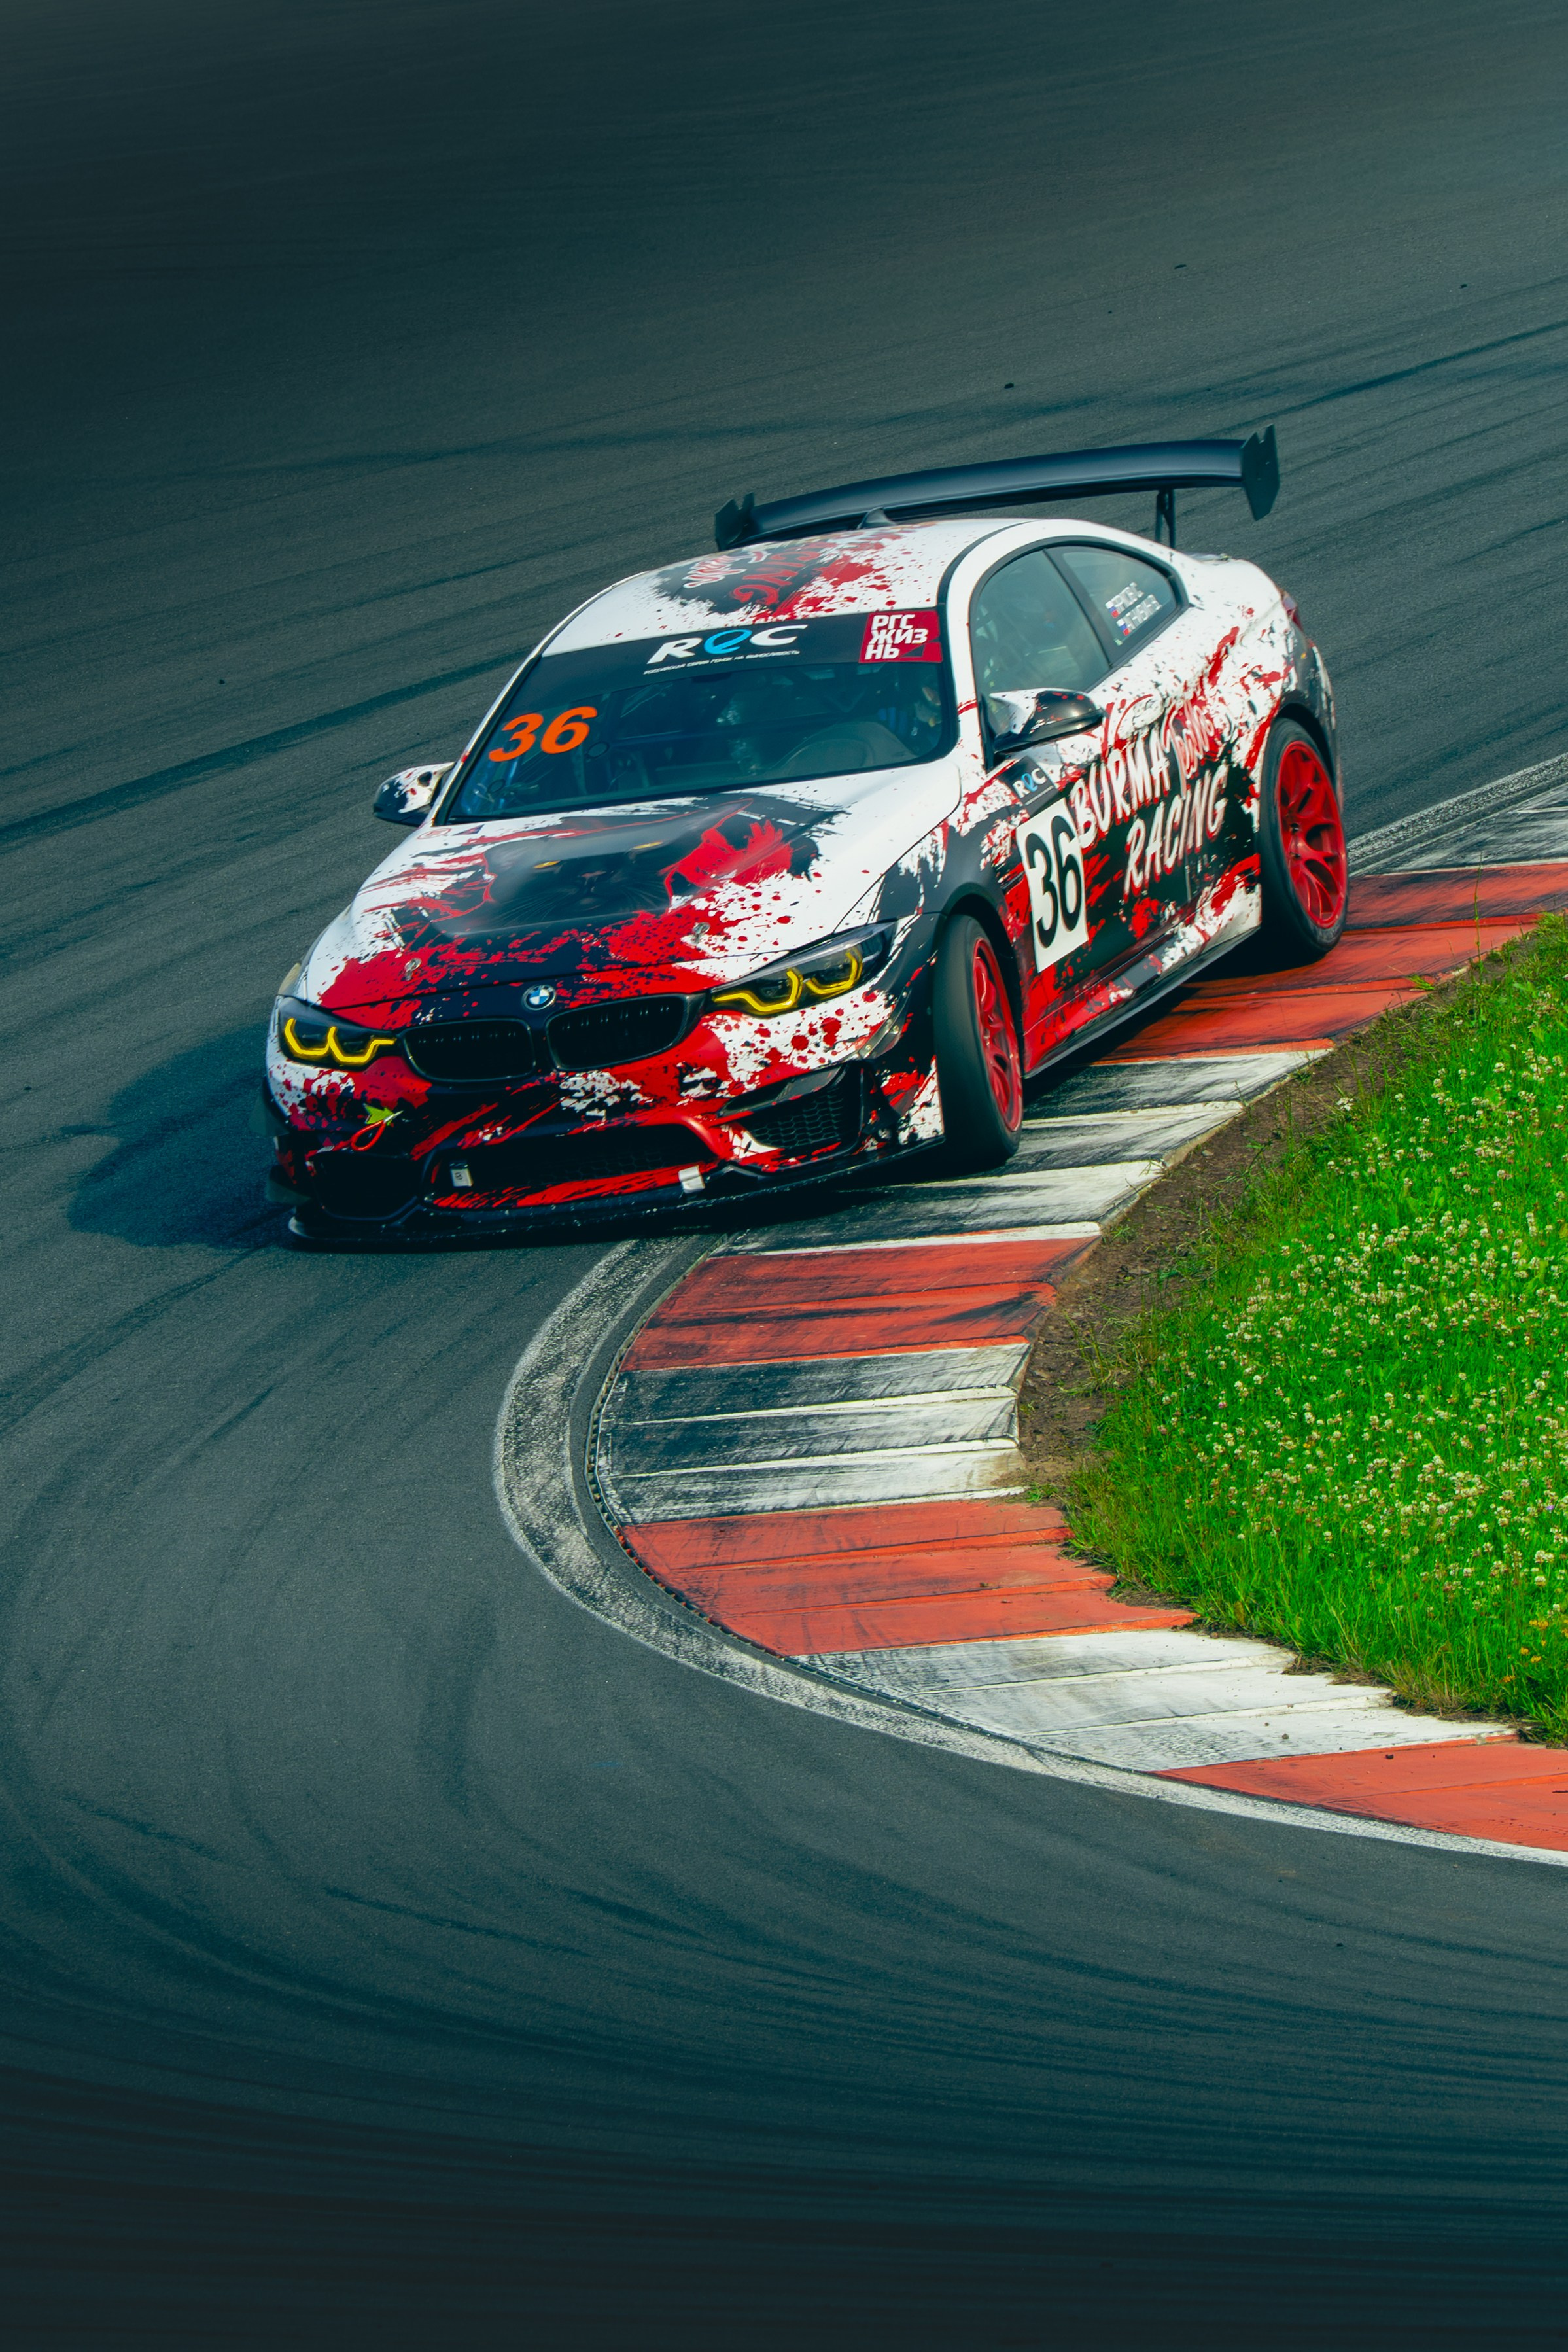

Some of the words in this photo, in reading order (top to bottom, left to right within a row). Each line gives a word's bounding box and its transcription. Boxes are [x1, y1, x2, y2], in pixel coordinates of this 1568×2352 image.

[868, 628, 929, 644] ЖИЗ
[871, 614, 916, 630] РГС
[864, 643, 900, 660] НЬ
[488, 705, 598, 762] 36
[1070, 722, 1171, 850] BURMA
[1123, 758, 1228, 900] RACING
[1025, 815, 1083, 949] 36
